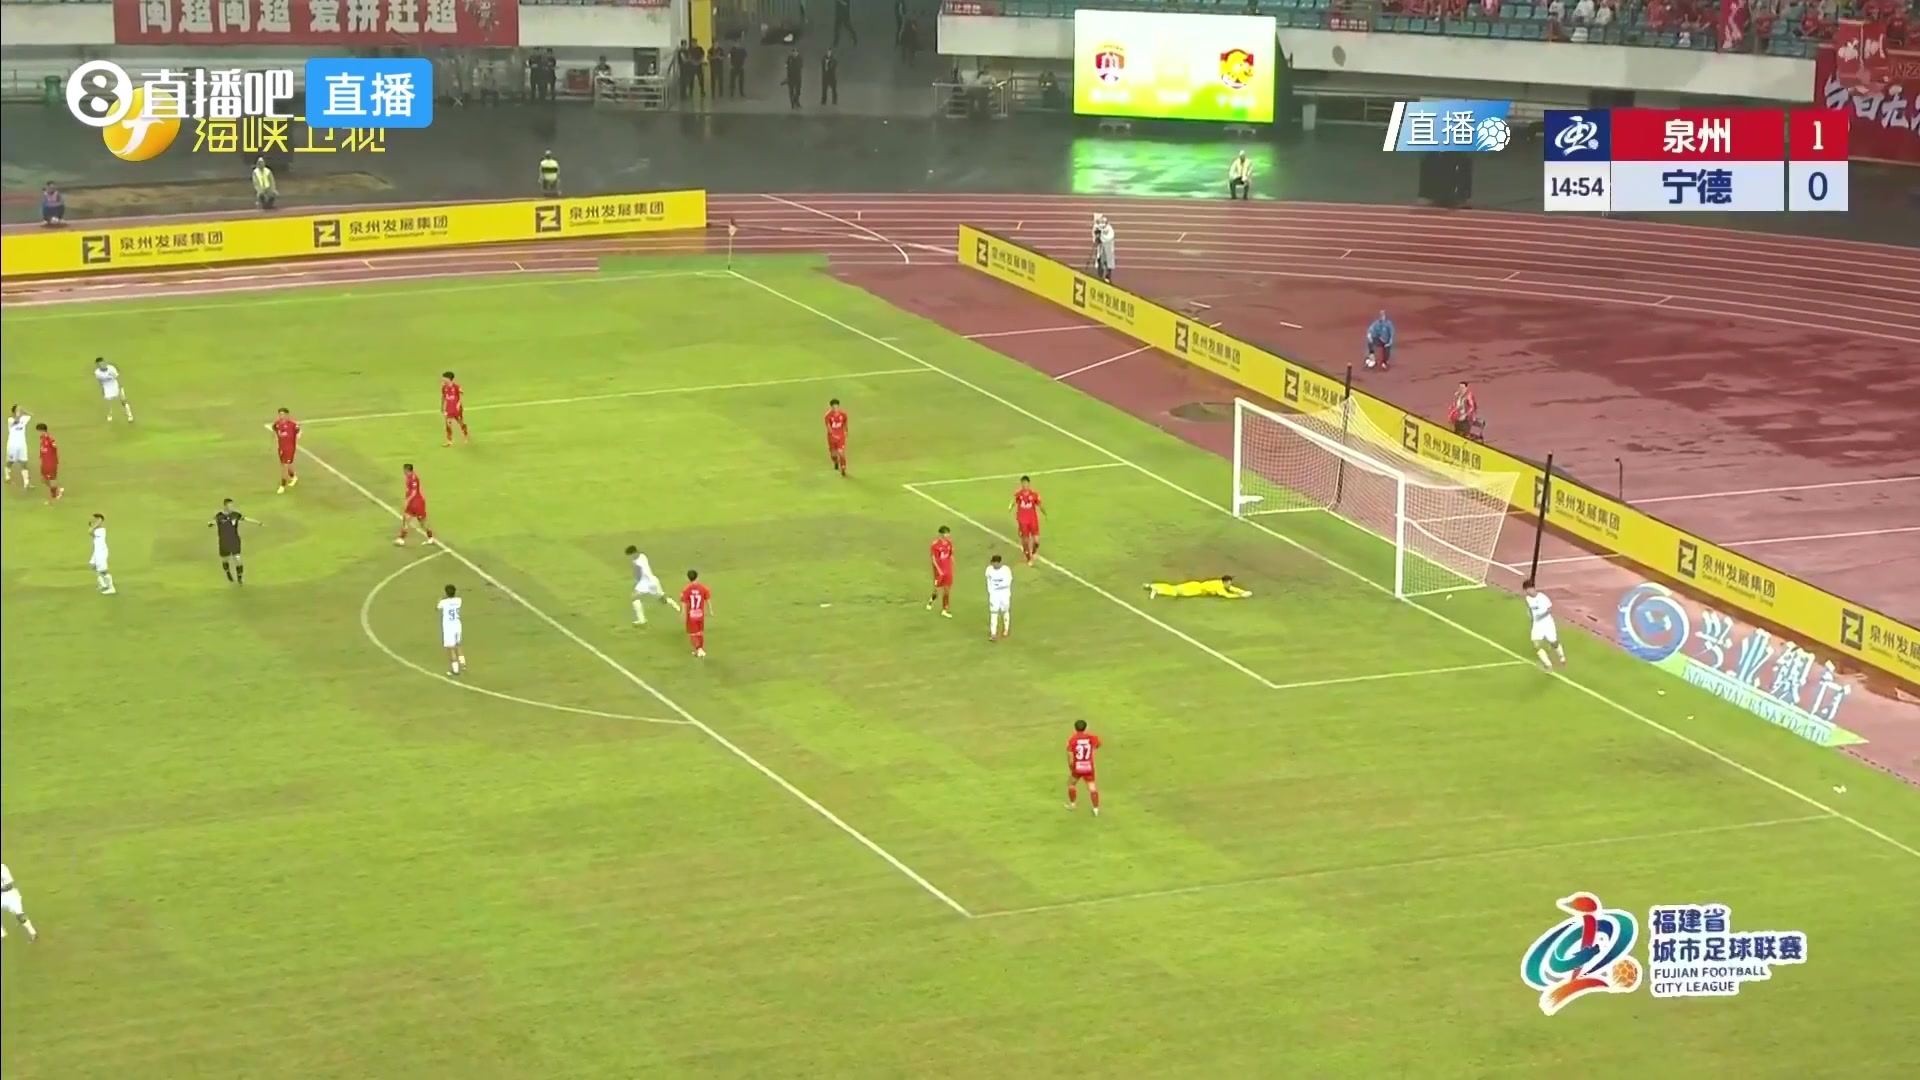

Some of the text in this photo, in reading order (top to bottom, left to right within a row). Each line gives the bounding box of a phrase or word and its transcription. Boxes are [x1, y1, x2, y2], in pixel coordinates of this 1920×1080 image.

[1702, 554, 1776, 598] 泉州发展集团
[689, 594, 702, 610] 17
[1075, 743, 1092, 760] 37
